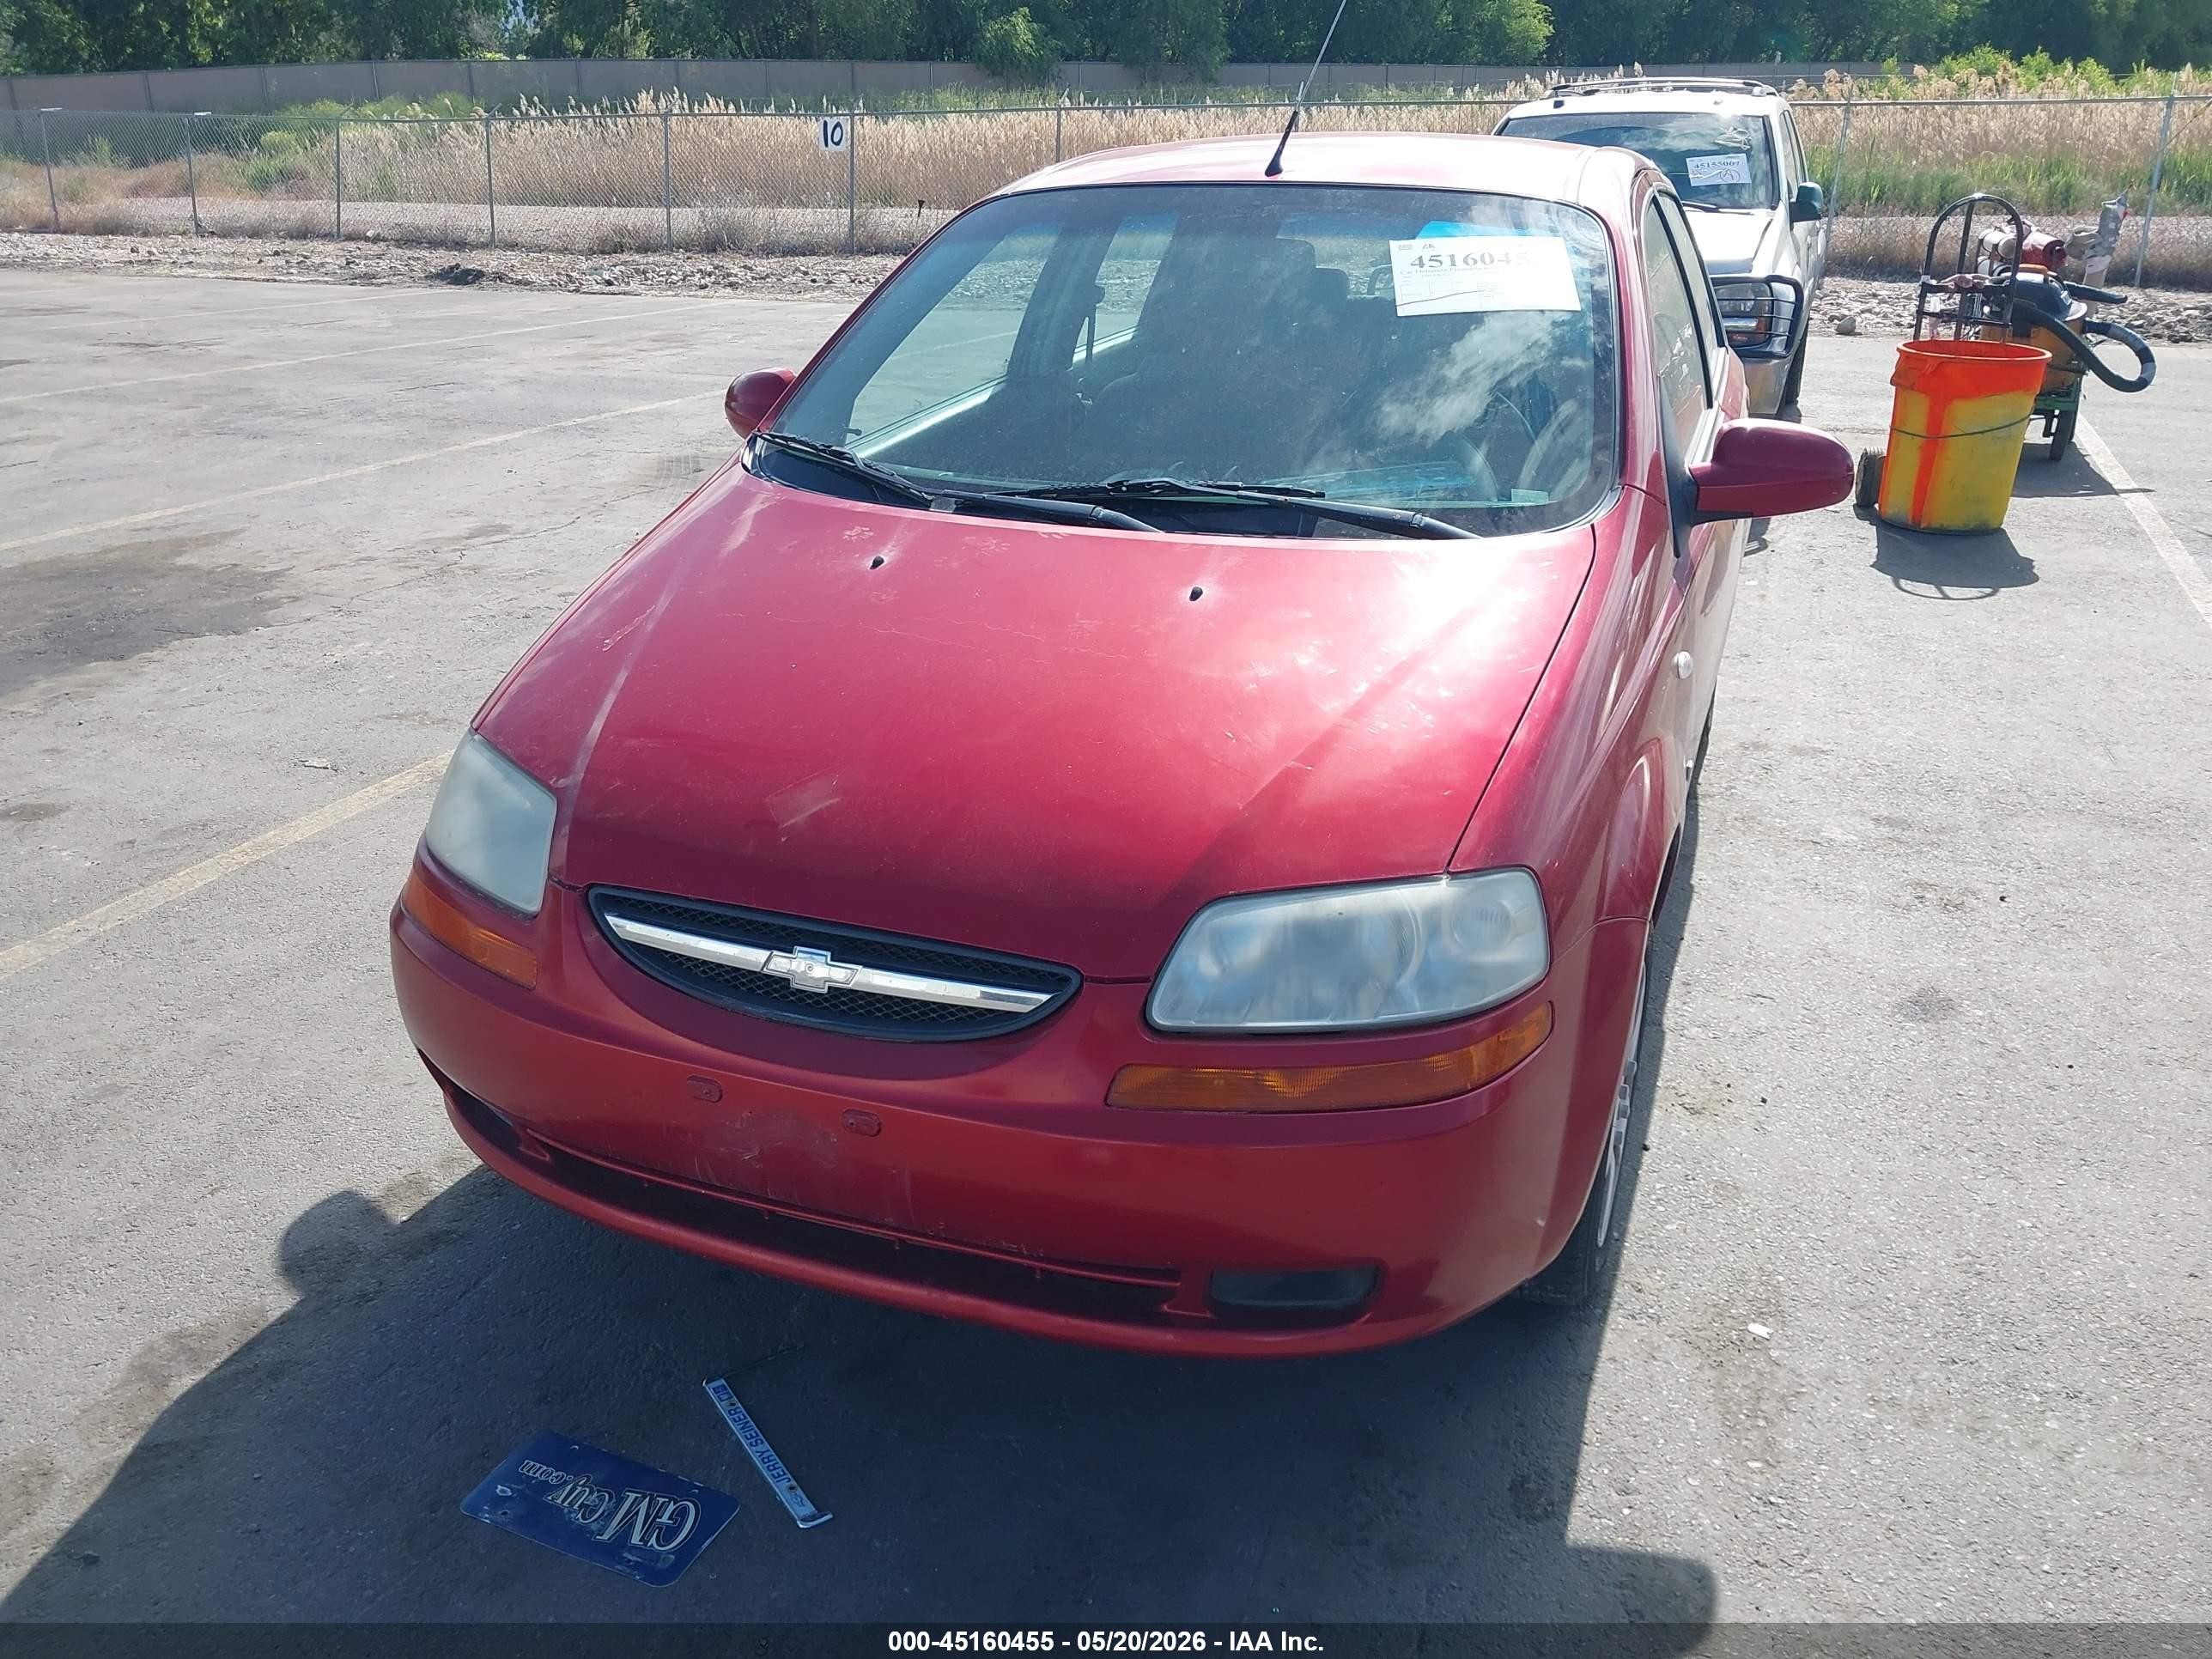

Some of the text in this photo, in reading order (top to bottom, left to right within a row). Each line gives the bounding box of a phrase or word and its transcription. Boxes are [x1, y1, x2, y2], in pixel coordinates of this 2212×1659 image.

[823, 120, 843, 148] 10
[728, 1406, 792, 1484] JERRY SEINER
